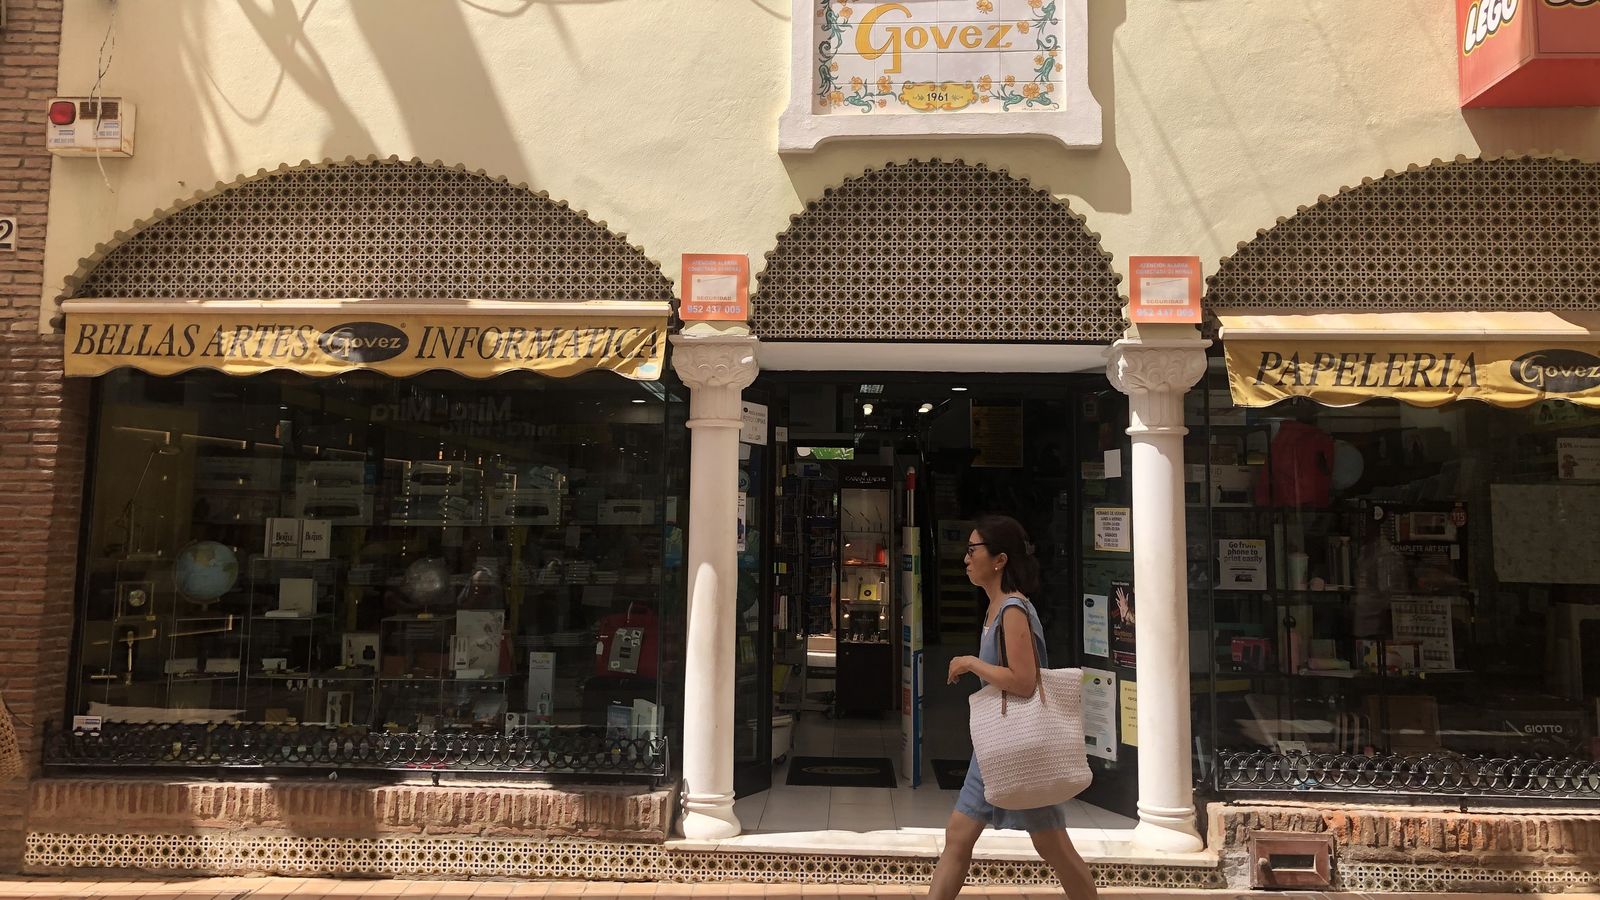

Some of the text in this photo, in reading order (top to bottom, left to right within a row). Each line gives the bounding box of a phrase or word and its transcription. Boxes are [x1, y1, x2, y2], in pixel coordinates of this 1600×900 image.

[855, 2, 1013, 75] Govez
[927, 92, 949, 102] 1961
[71, 322, 316, 359] BELLAS ARTES
[326, 327, 402, 357] Govez
[1252, 350, 1482, 388] PAPELERIA
[1520, 354, 1600, 387] Govez
[1227, 548, 1249, 556] phone
[1390, 544, 1423, 552] COMPLETE
[1242, 556, 1263, 564] easily
[1524, 724, 1563, 734] GIOTTO
